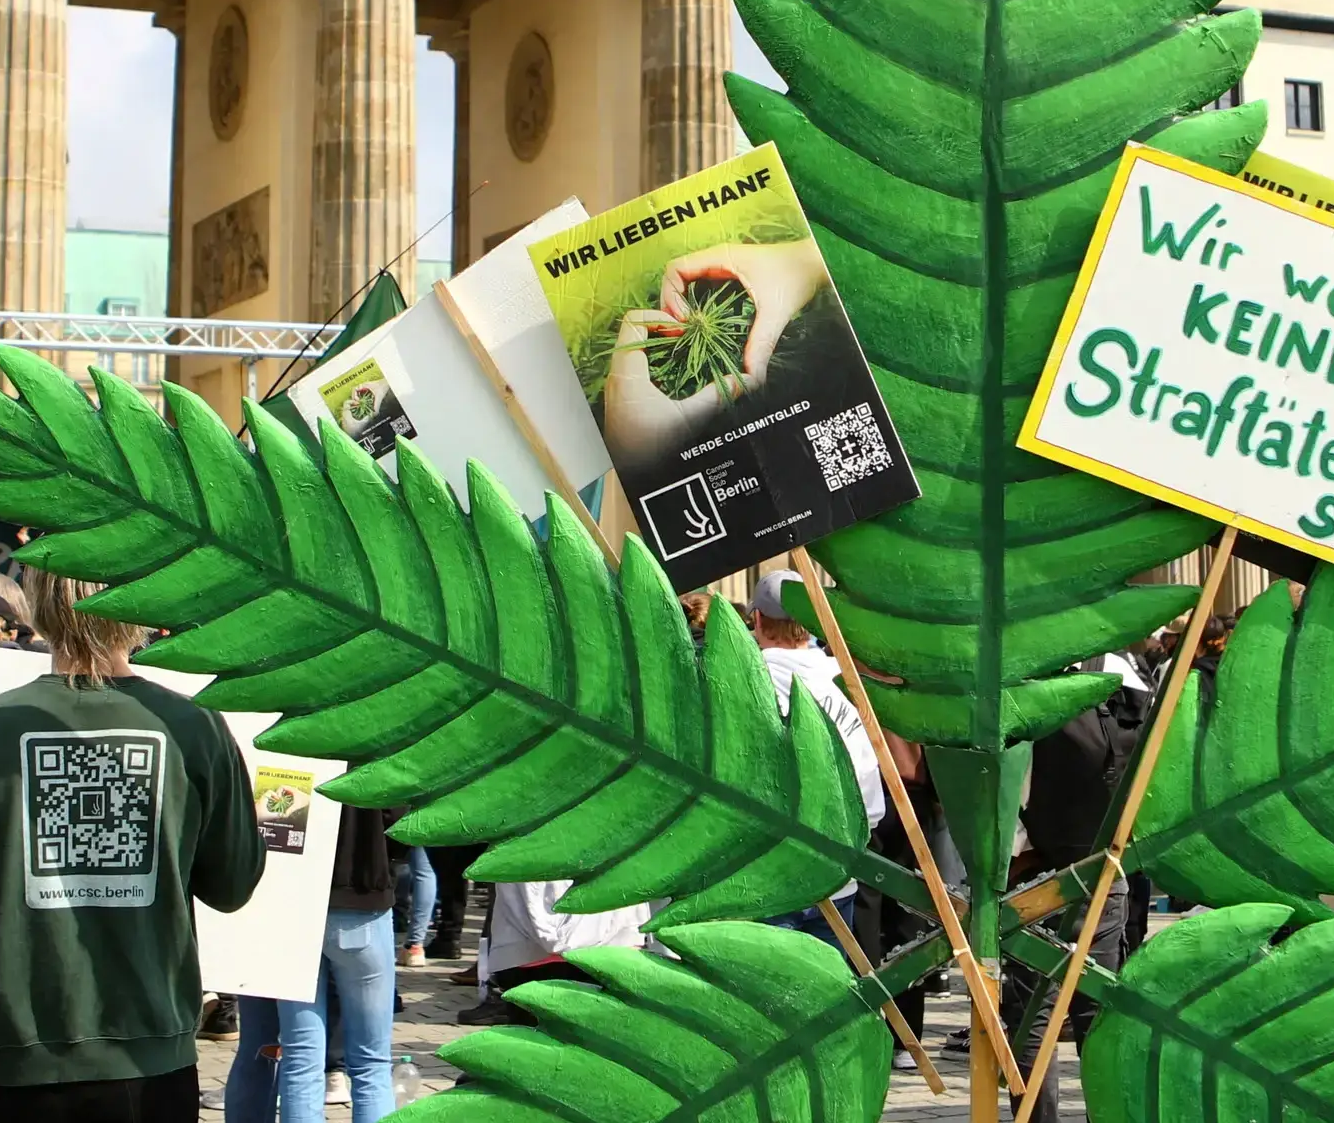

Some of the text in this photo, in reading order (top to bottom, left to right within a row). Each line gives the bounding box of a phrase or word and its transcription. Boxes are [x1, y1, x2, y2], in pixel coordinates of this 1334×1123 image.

[544, 168, 771, 279] WIR LIEBEN HANF
[1139, 184, 1244, 272] Wir
[323, 362, 375, 396] WIR LIEBEN HANF
[680, 400, 811, 461] WERDE CLUBMITGLIED
[705, 459, 735, 476] Cannabis
[708, 469, 728, 483] Social
[711, 479, 727, 489] Club
[714, 476, 759, 502] Berlin
[753, 509, 813, 539] WWW.CSC.BERLIN
[817, 695, 862, 738] OWN
[271, 772, 294, 780] LIEBEN
[39, 885, 144, 900] www.csc.berlin
